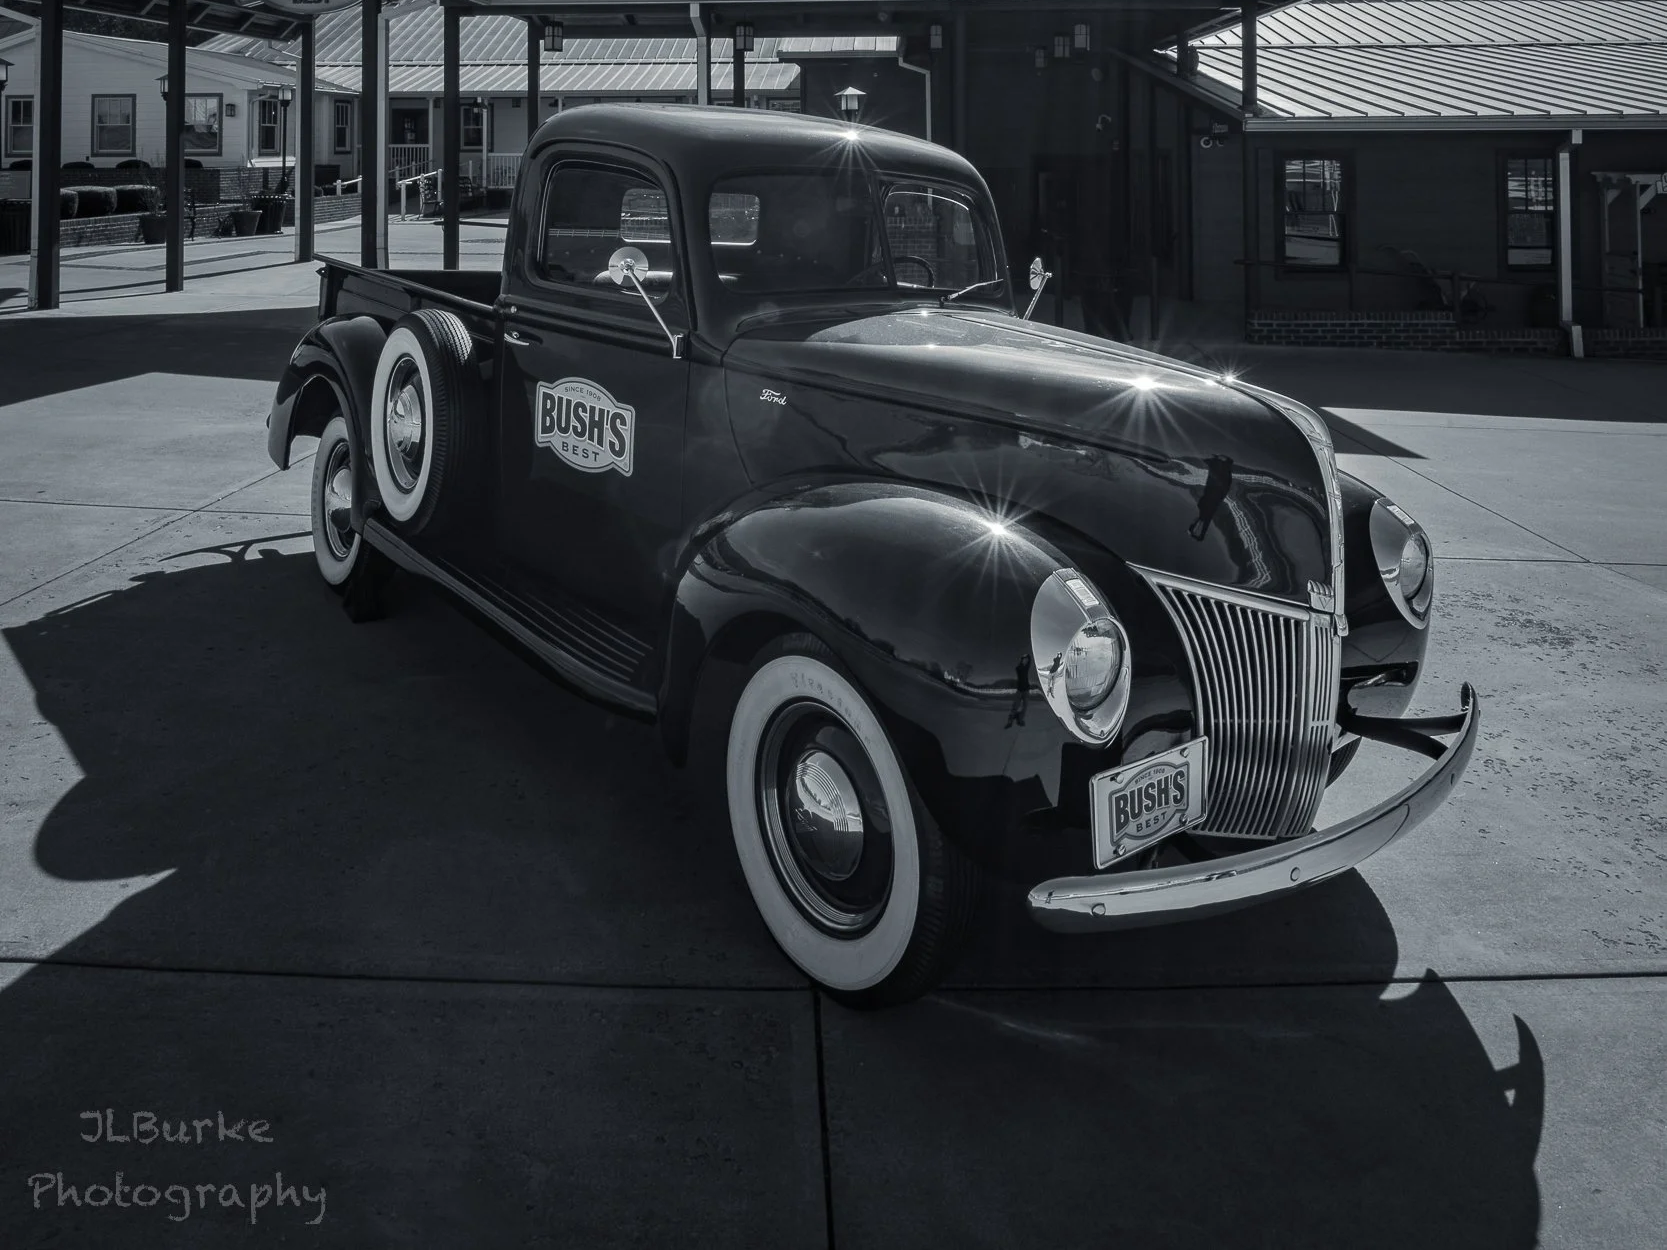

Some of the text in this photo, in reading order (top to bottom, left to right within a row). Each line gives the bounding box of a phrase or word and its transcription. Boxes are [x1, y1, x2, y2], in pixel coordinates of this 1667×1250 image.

[564, 386, 584, 394] SINCE
[760, 388, 787, 406] Ford
[541, 390, 628, 459] BUSH'S
[562, 441, 600, 462] BEST
[1114, 770, 1185, 833] BUSH'S
[1136, 811, 1167, 832] BEST
